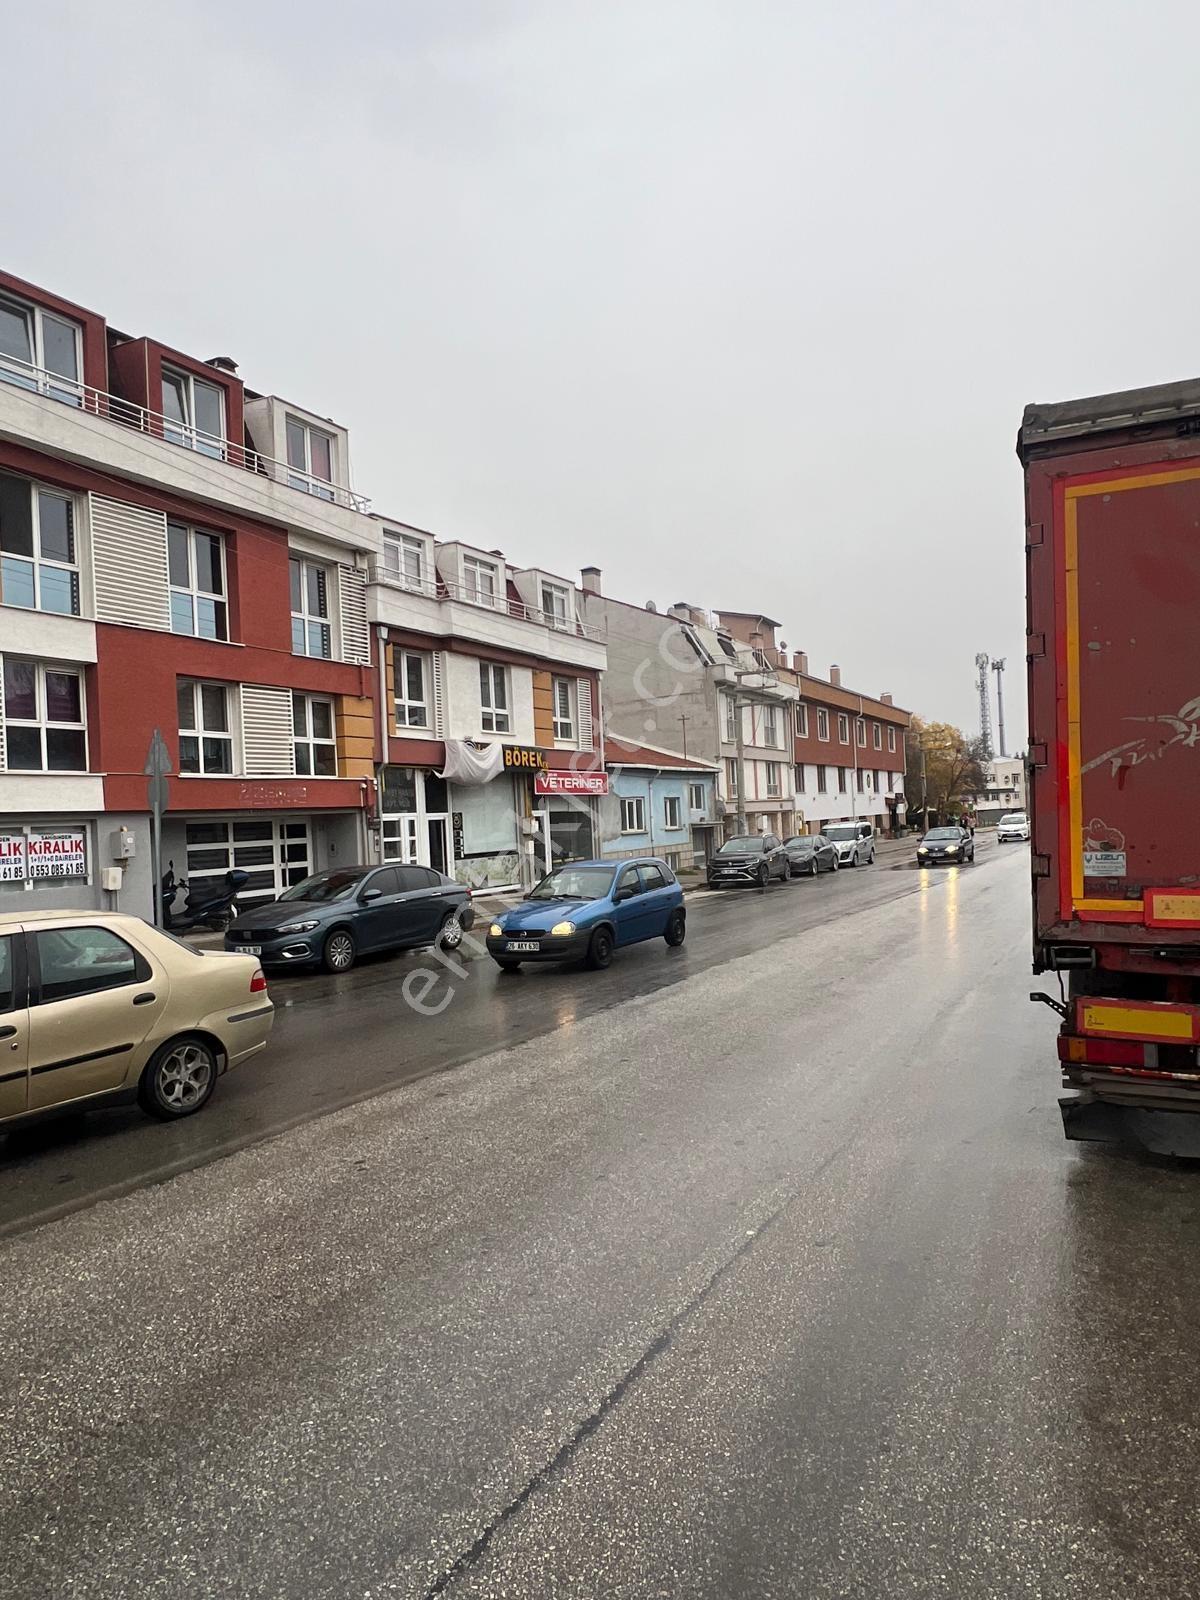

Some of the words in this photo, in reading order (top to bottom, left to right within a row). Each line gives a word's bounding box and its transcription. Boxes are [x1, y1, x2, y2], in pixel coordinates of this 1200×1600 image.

[505, 747, 543, 767] BÖREK
[3, 867, 12, 879] 61
[14, 866, 23, 878] 85
[30, 865, 35, 876] 0
[36, 864, 50, 876] 553
[51, 863, 64, 875] 085
[65, 863, 74, 874] 61
[75, 862, 84, 873] 85
